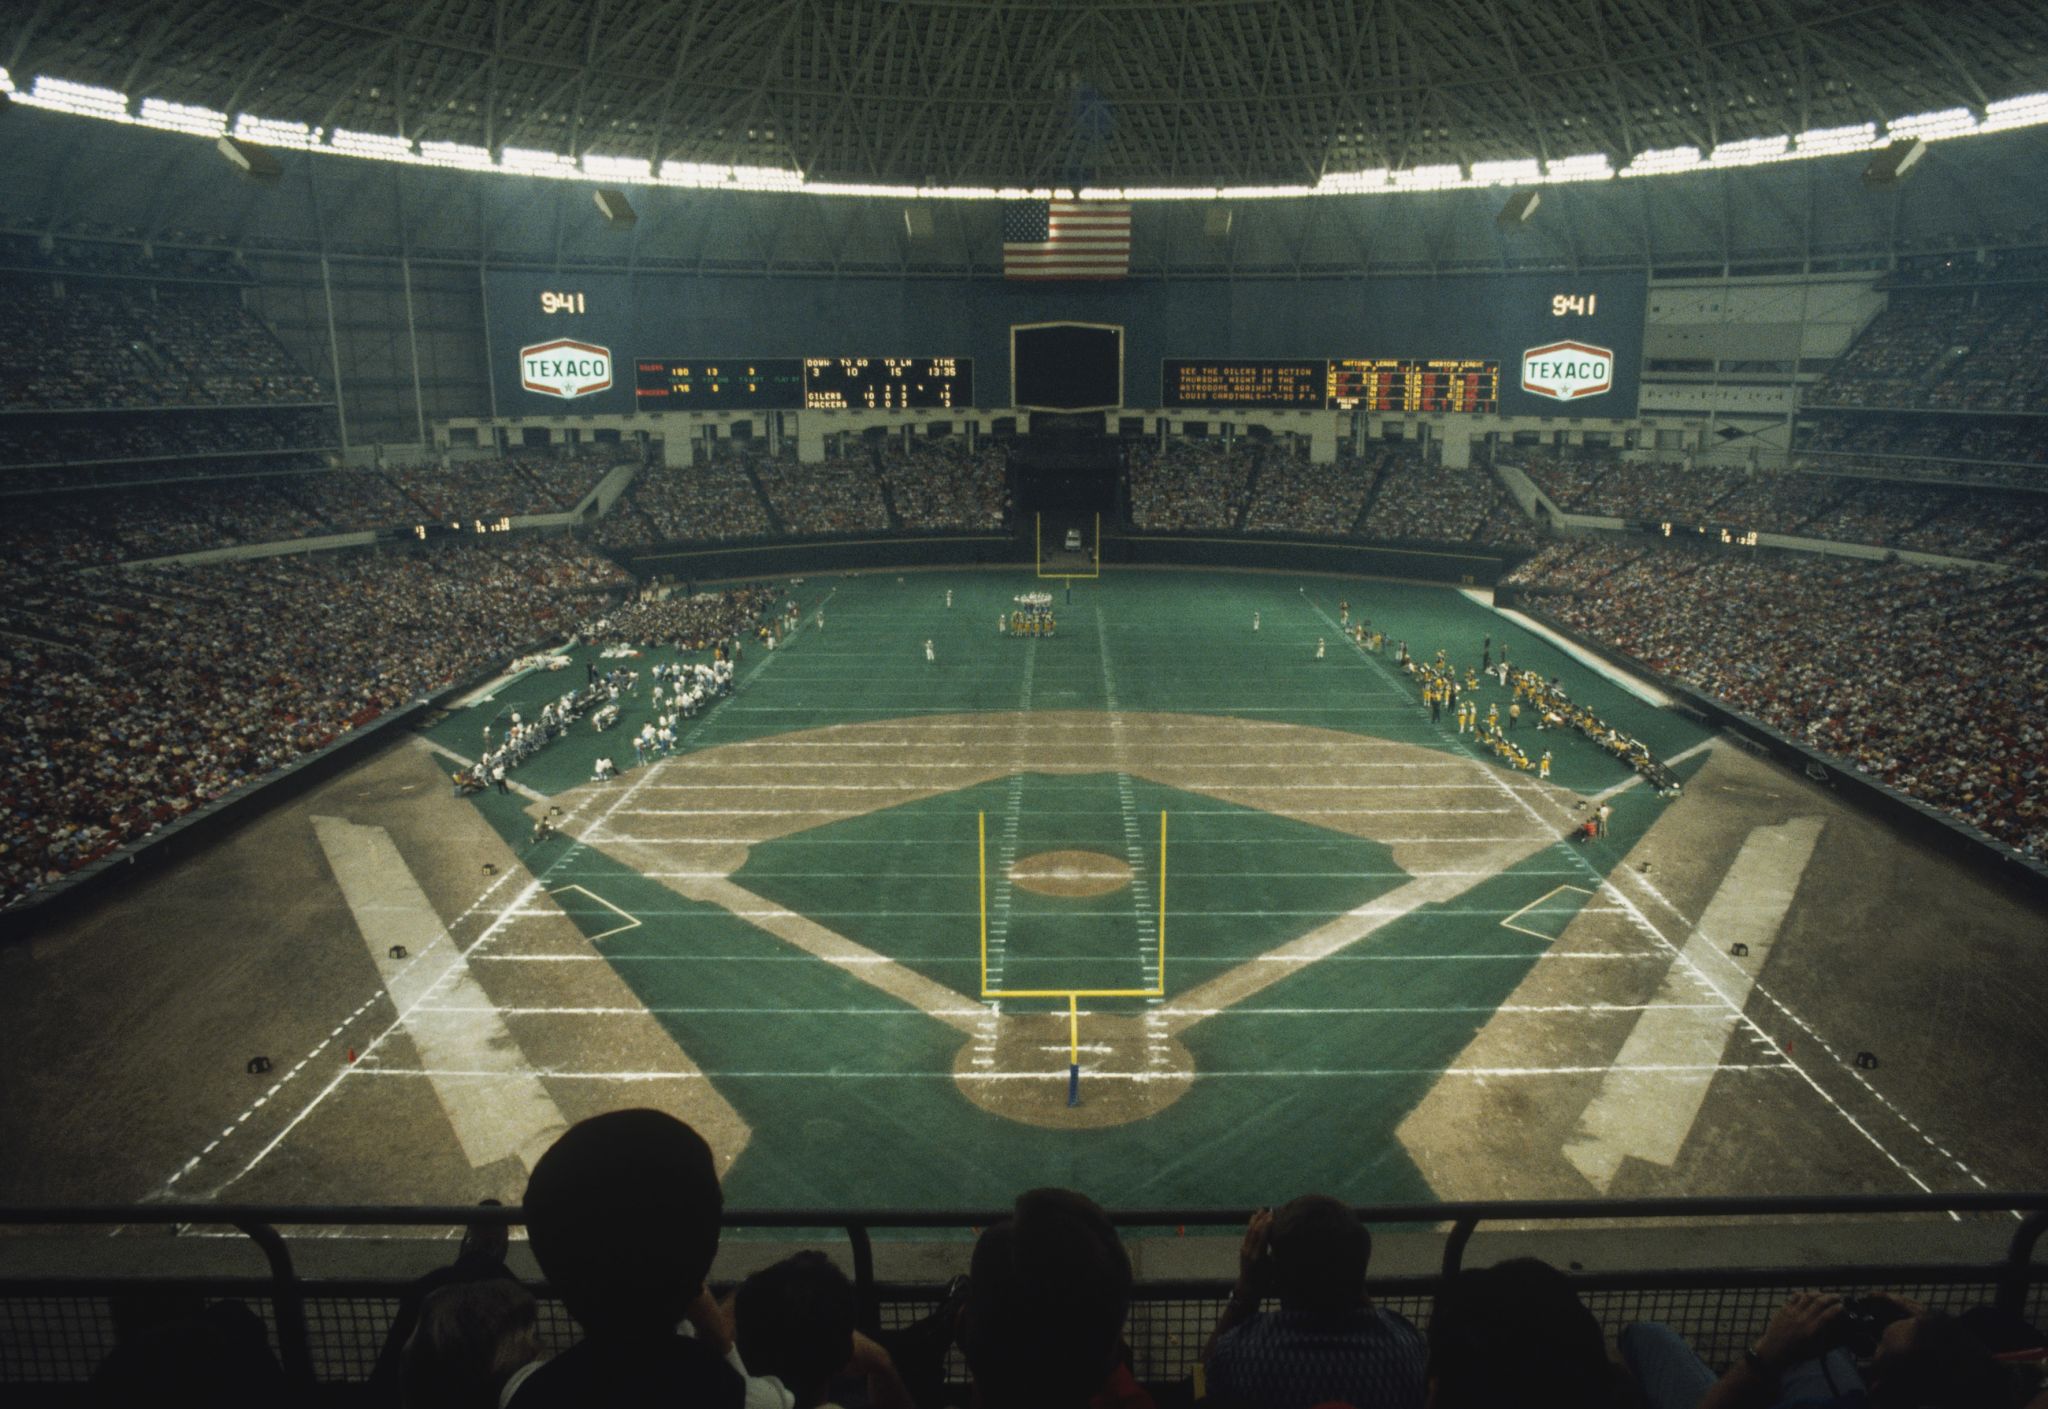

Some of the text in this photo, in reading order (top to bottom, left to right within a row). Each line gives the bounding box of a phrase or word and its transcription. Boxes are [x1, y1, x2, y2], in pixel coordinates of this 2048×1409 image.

[857, 359, 869, 367] GO
[934, 358, 955, 366] TIME
[527, 360, 604, 377] TEXACO
[813, 368, 820, 377] 3
[847, 368, 858, 376] 10
[890, 368, 902, 376] 15
[1278, 368, 1312, 376] ACTION
[1528, 362, 1605, 379] TEXACO
[1234, 384, 1272, 392] AGAINST
[1279, 384, 1294, 392] THE
[864, 392, 874, 400] 10
[808, 400, 848, 408] PACKERS
